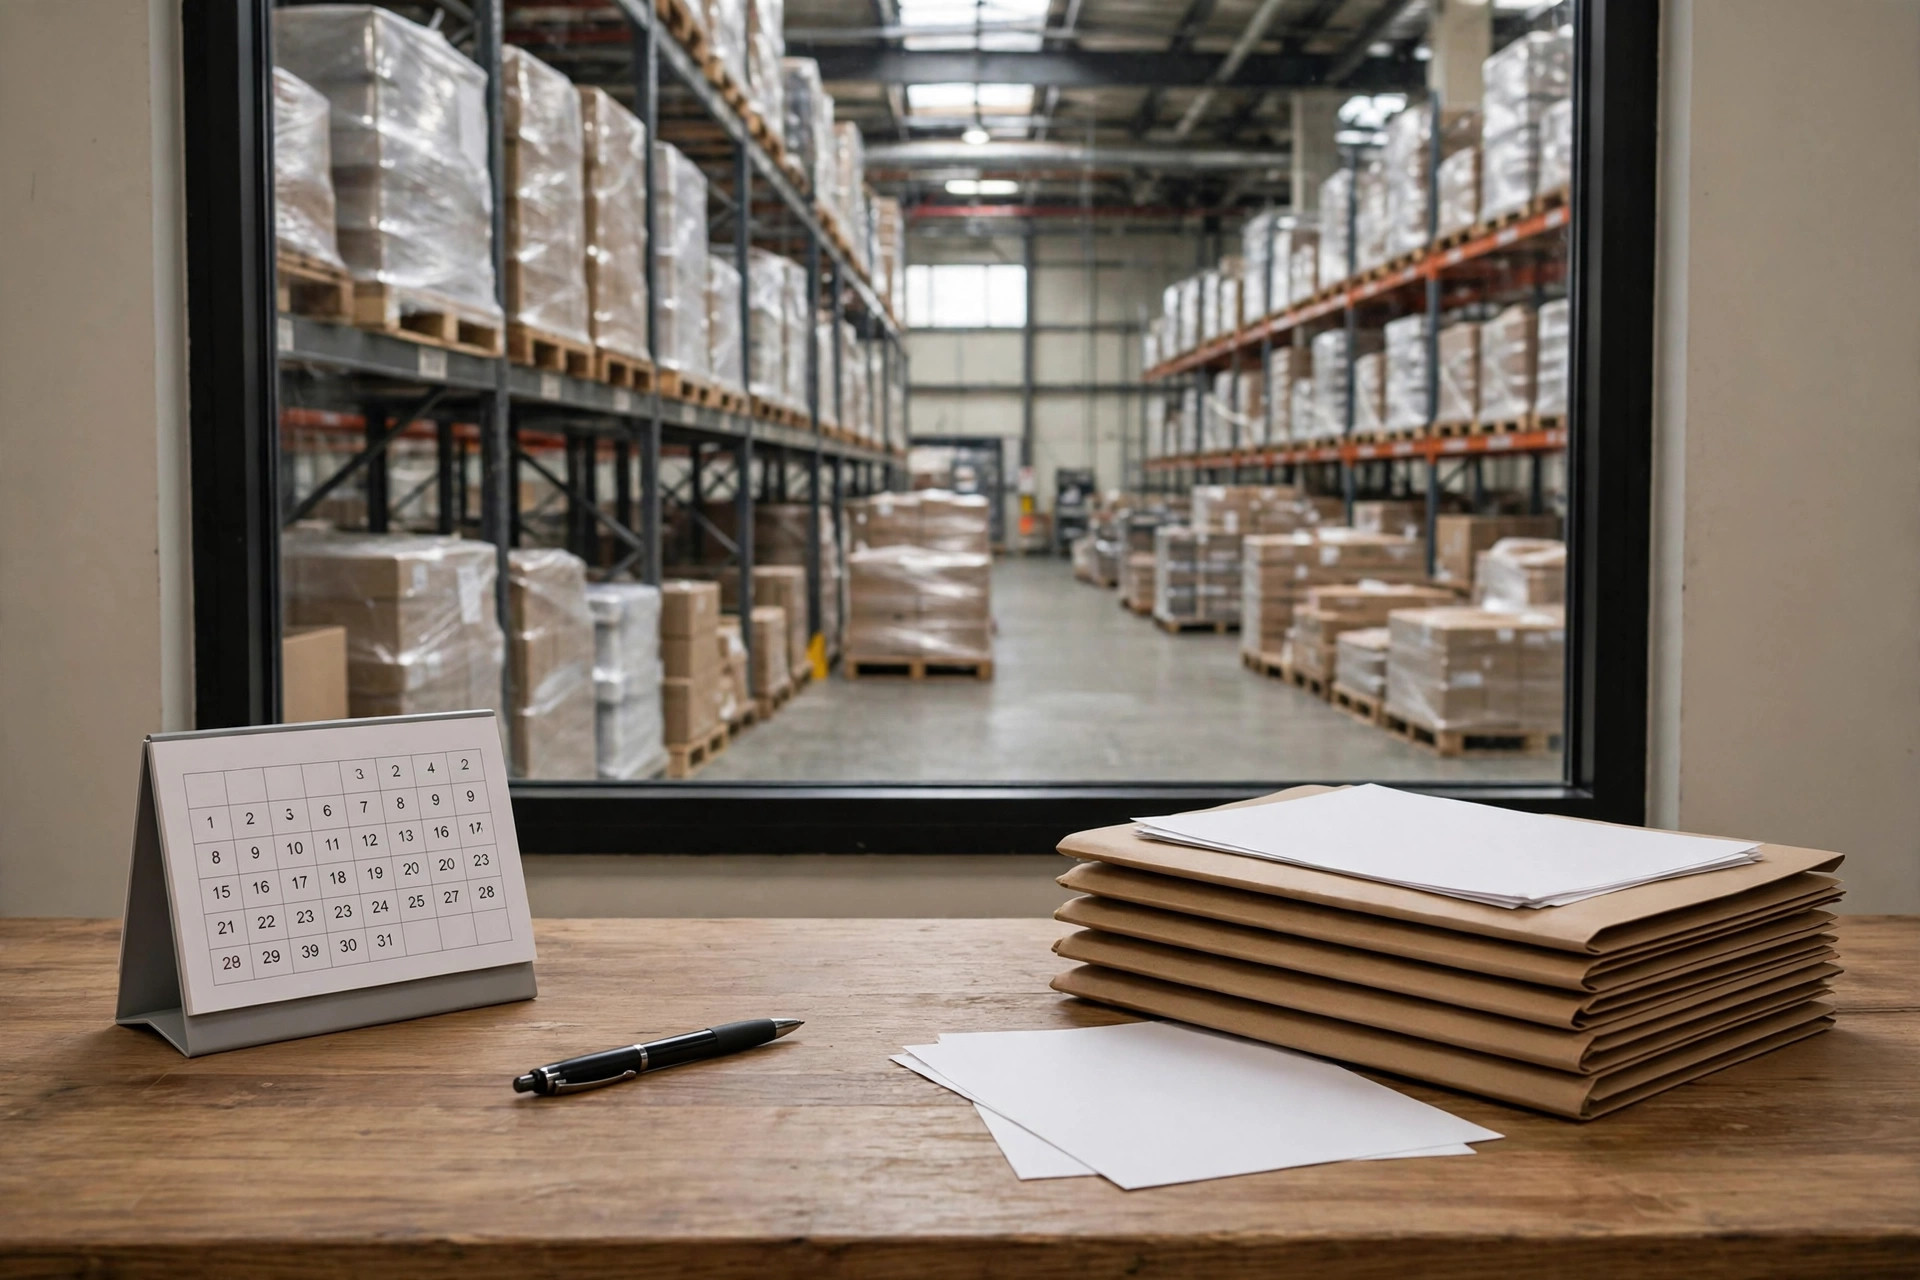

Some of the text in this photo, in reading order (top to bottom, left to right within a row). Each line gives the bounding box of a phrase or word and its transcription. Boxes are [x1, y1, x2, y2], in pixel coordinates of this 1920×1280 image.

[355, 758, 469, 780] 3 2 4 2
[207, 816, 213, 829] 1
[245, 812, 255, 825] 2
[323, 804, 332, 817] 6
[360, 801, 368, 813] 7
[396, 797, 405, 810] 8
[431, 793, 440, 806] 9
[466, 790, 475, 802] 9
[212, 850, 221, 864] 8
[251, 846, 260, 859] 9
[287, 841, 303, 855] 10
[325, 838, 339, 851] 11
[362, 833, 378, 847] 12
[398, 829, 414, 842] 13
[434, 825, 449, 839] 16
[213, 853, 489, 899] 15 16 17 18 19 20 20 23
[217, 885, 495, 935] 21 22 23 23 24 25 27 28
[222, 933, 393, 970] 28 29 39 30 31
